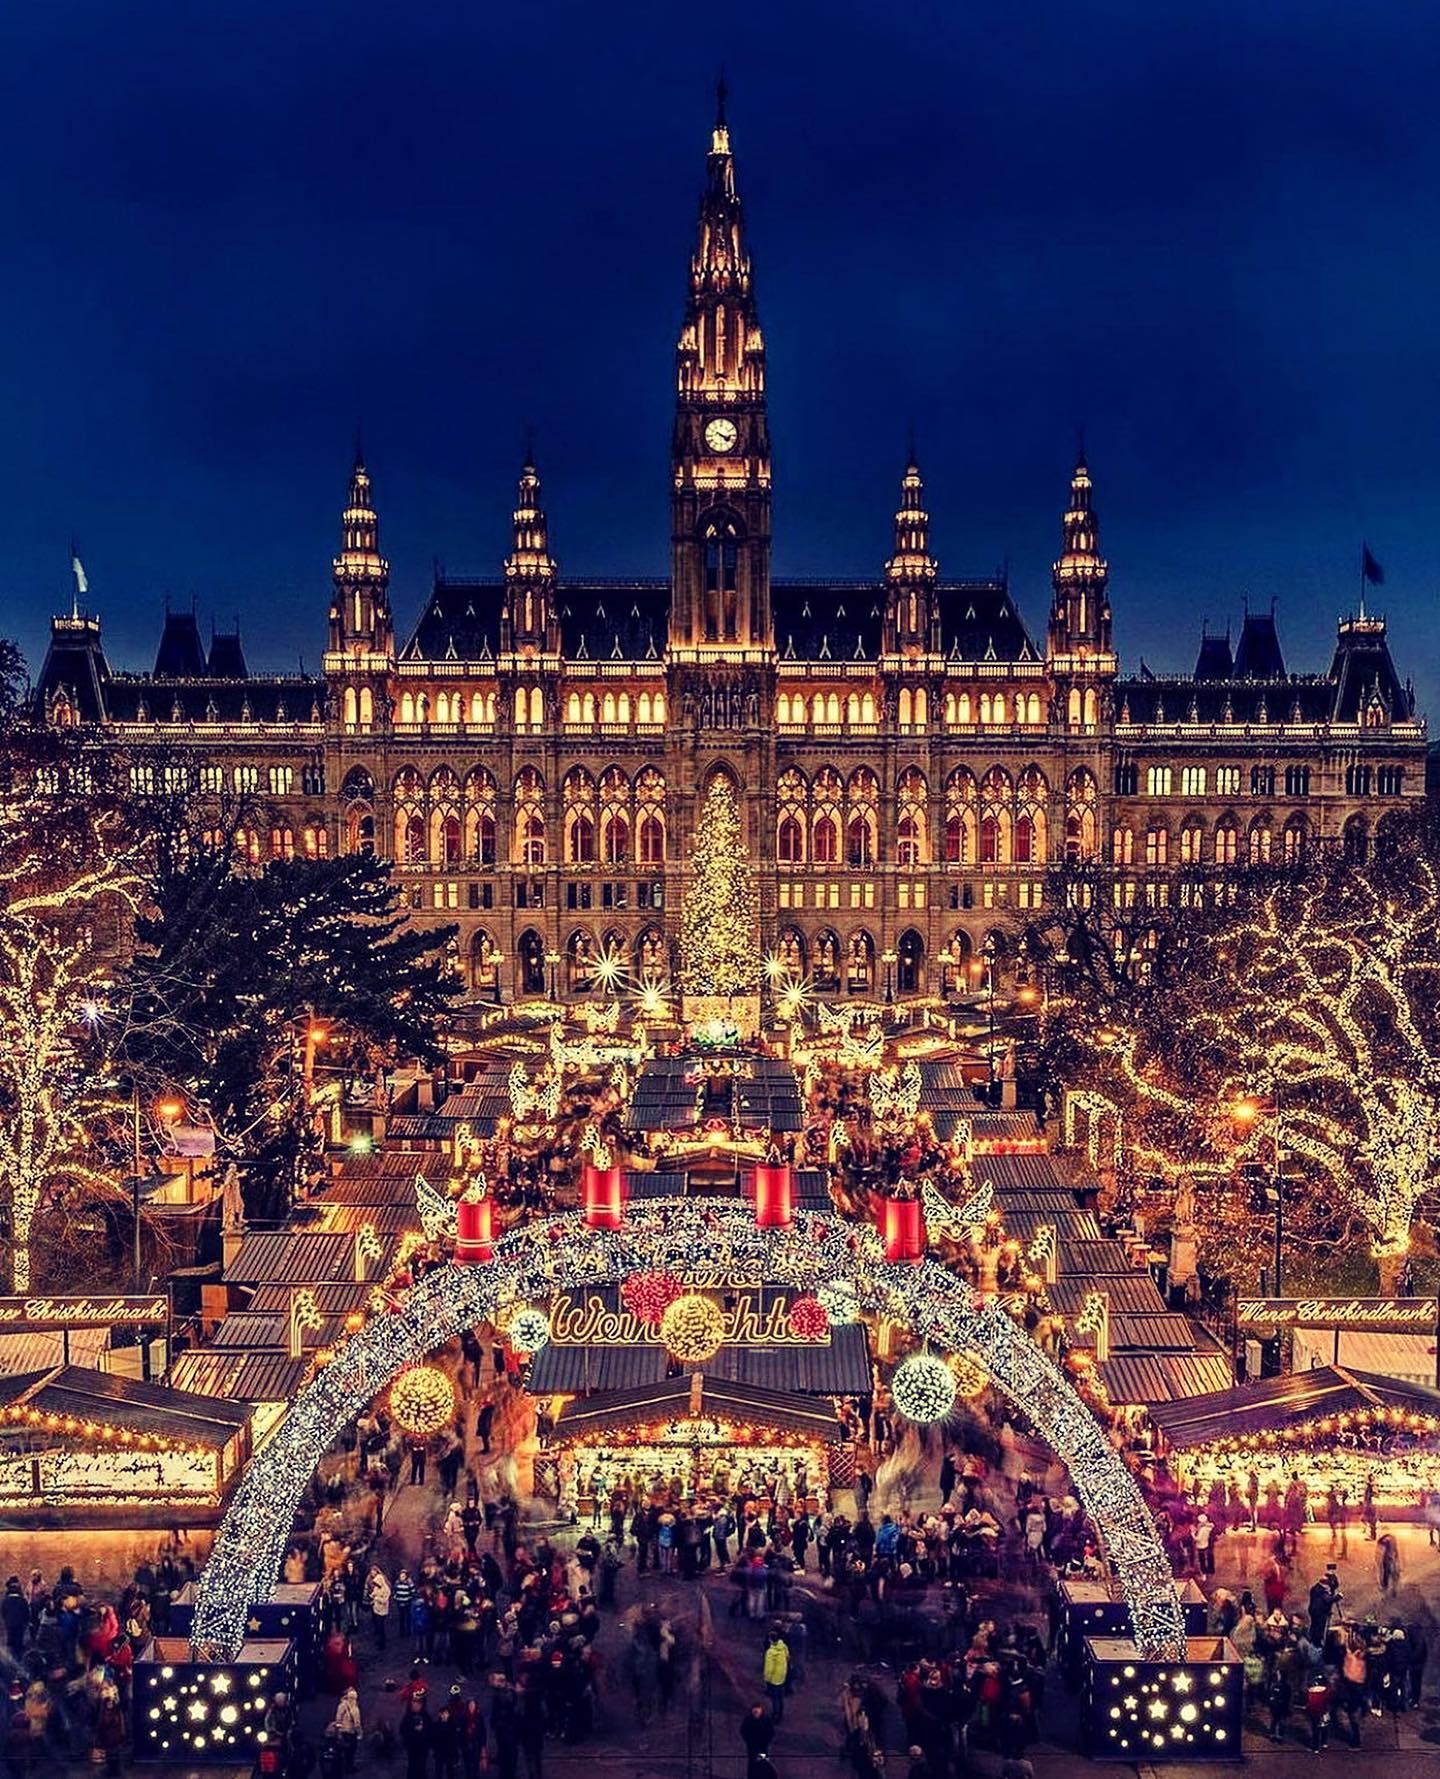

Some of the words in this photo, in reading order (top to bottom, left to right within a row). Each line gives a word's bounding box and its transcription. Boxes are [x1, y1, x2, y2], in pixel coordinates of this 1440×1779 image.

[24, 1299, 167, 1321] Christkindlmarkt
[1238, 1301, 1296, 1322] Wiener
[1296, 1300, 1437, 1322] Christkindlmarkt
